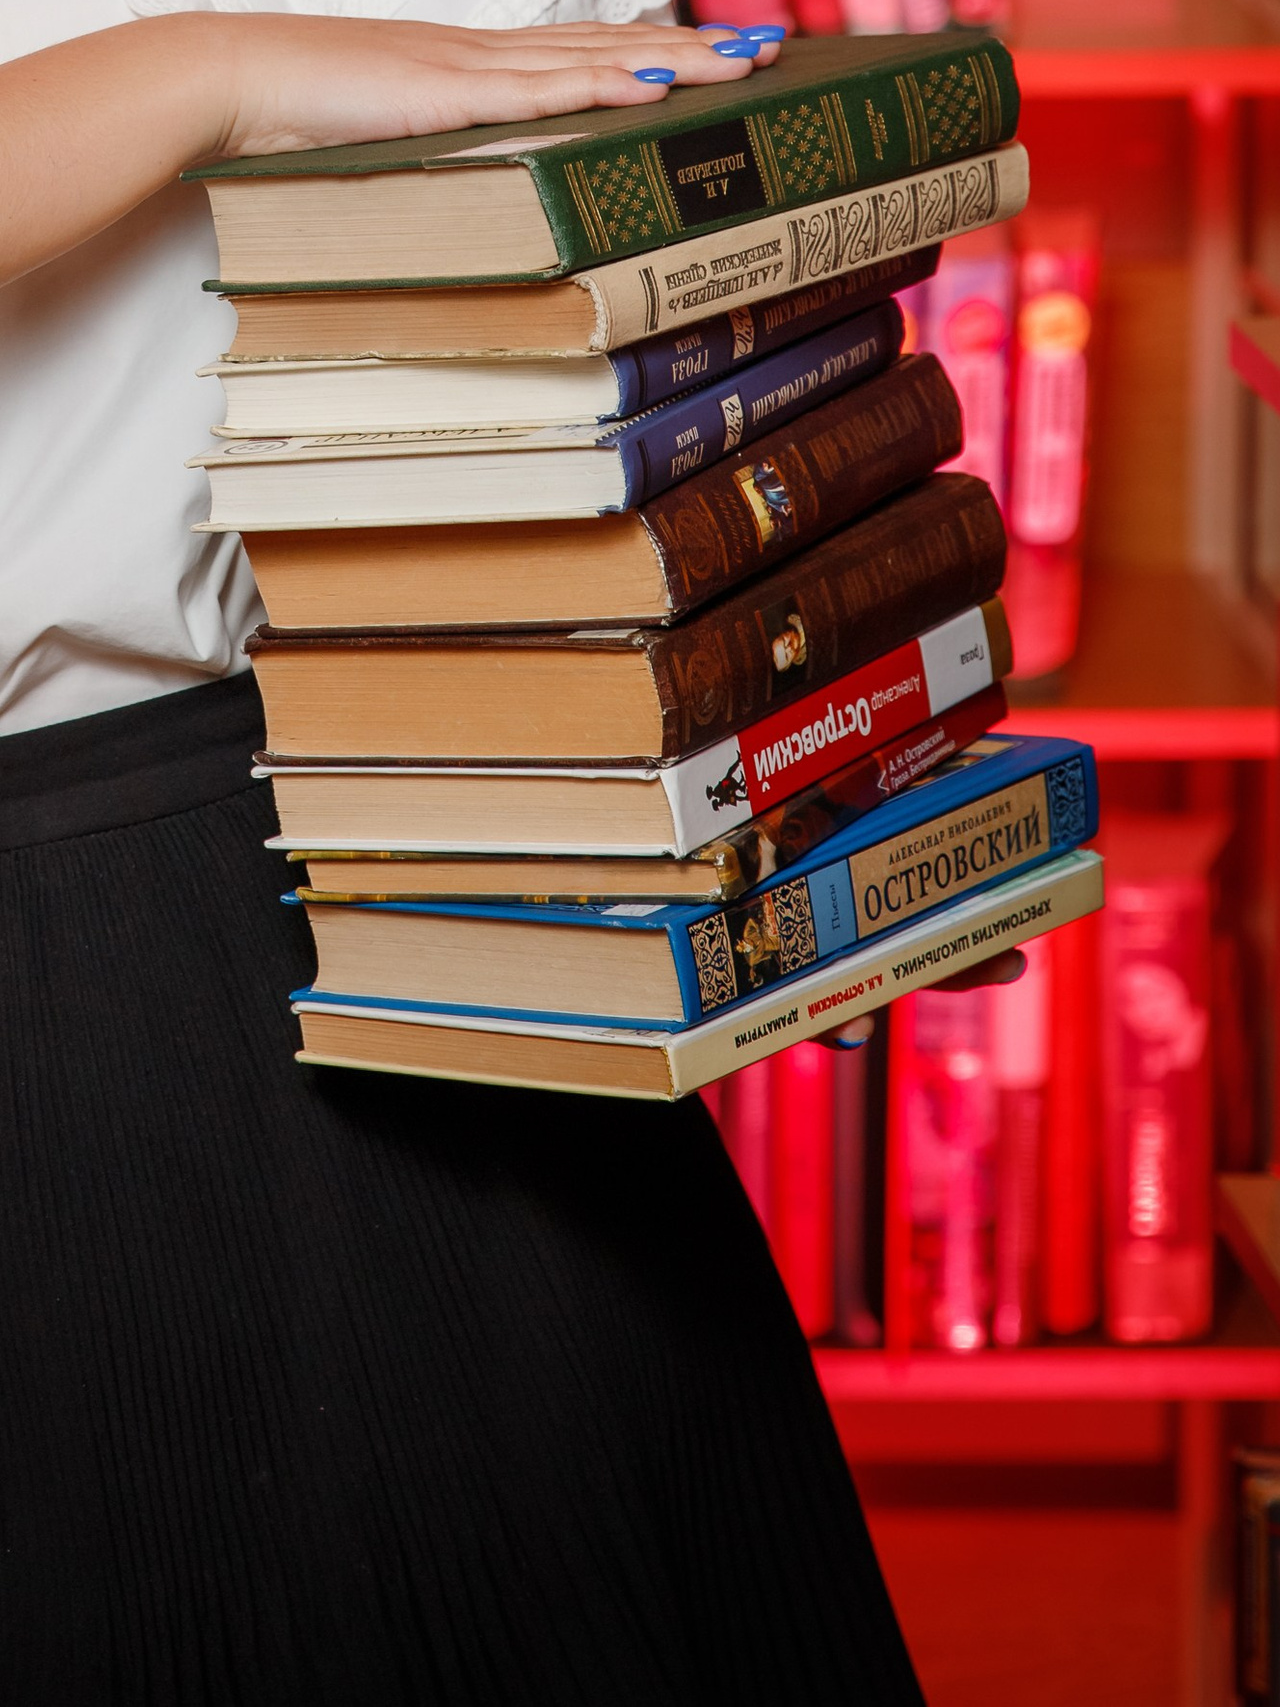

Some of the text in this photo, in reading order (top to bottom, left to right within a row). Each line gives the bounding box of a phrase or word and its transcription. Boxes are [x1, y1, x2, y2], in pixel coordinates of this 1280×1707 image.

[677, 153, 746, 185] ПОЛЕЖАЕВ
[664, 239, 782, 291] ЖИТЕЙСКИЕ СЦЕНЫ
[682, 274, 745, 310] ПЛЕЩЕЕВ
[671, 348, 709, 384] ГРОЗА
[751, 370, 818, 426] ОСТРОВСКИЙ
[677, 425, 700, 448] ПЬЕСЫ
[671, 442, 705, 479] ГРОЗА
[960, 643, 985, 667] Гроза
[753, 674, 921, 792] Александр Островский
[904, 726, 946, 763] Островский
[888, 801, 1012, 866] АЛЕКСАНДР НИКОЛАЕВИЧ
[864, 804, 1043, 922] ОСТРОВСКИЙ
[831, 883, 841, 932] Пьесы
[891, 899, 1053, 981] ХРЕСТОМАТИЯ ШКОЛЬНИКА
[807, 973, 884, 1020] А.Н. ОСТРОВСКИЙ
[734, 1008, 800, 1049] ДРАМАТУРГИЯ
